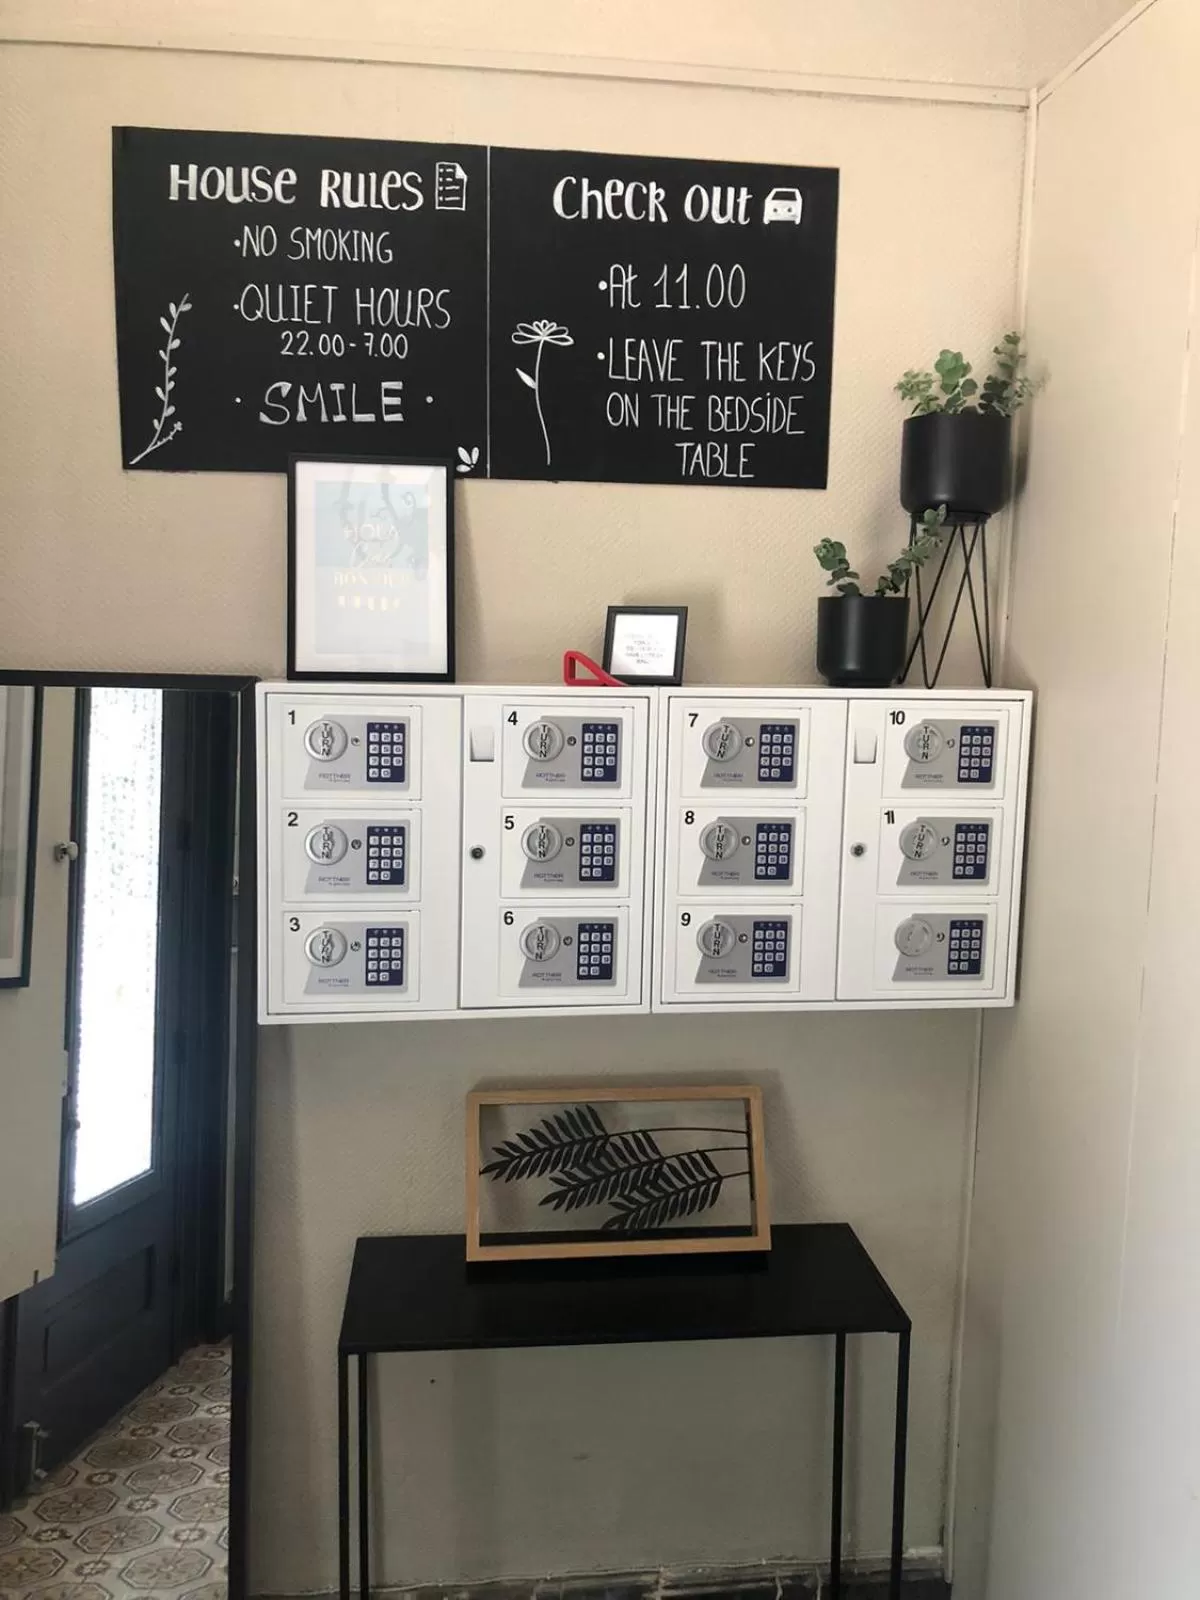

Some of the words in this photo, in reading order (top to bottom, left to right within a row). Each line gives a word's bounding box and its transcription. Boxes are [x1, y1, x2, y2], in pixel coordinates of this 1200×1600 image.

[243, 225, 277, 257] NO
[287, 227, 392, 263] SMOKING
[610, 264, 640, 309] At
[654, 264, 745, 309] 11.00
[240, 284, 338, 324] QUIET
[356, 288, 450, 328] HOURS
[609, 338, 683, 382] LEAVE
[701, 341, 746, 381] THE
[759, 342, 815, 381] KEYS
[260, 381, 403, 424] SMILE
[607, 392, 638, 427] ON
[651, 394, 695, 430] THE
[675, 442, 755, 477] TABLE
[288, 711, 295, 724] 1
[508, 711, 518, 725] 4
[689, 713, 698, 727] 7
[890, 711, 905, 725] 10
[322, 723, 331, 755] TURN
[539, 725, 548, 757] TURN
[717, 725, 729, 758] TURN
[288, 812, 298, 826] 2
[505, 816, 514, 830] 5
[685, 811, 694, 824] 8
[884, 811, 894, 824] 11
[322, 827, 330, 858] TURN
[716, 825, 724, 858] TURN
[915, 825, 926, 858] TURN
[290, 917, 300, 932] 3
[504, 911, 513, 925] 6
[681, 913, 690, 926] 9
[322, 931, 330, 963] TURN
[536, 926, 545, 959] TURN
[713, 923, 721, 955] TURN
